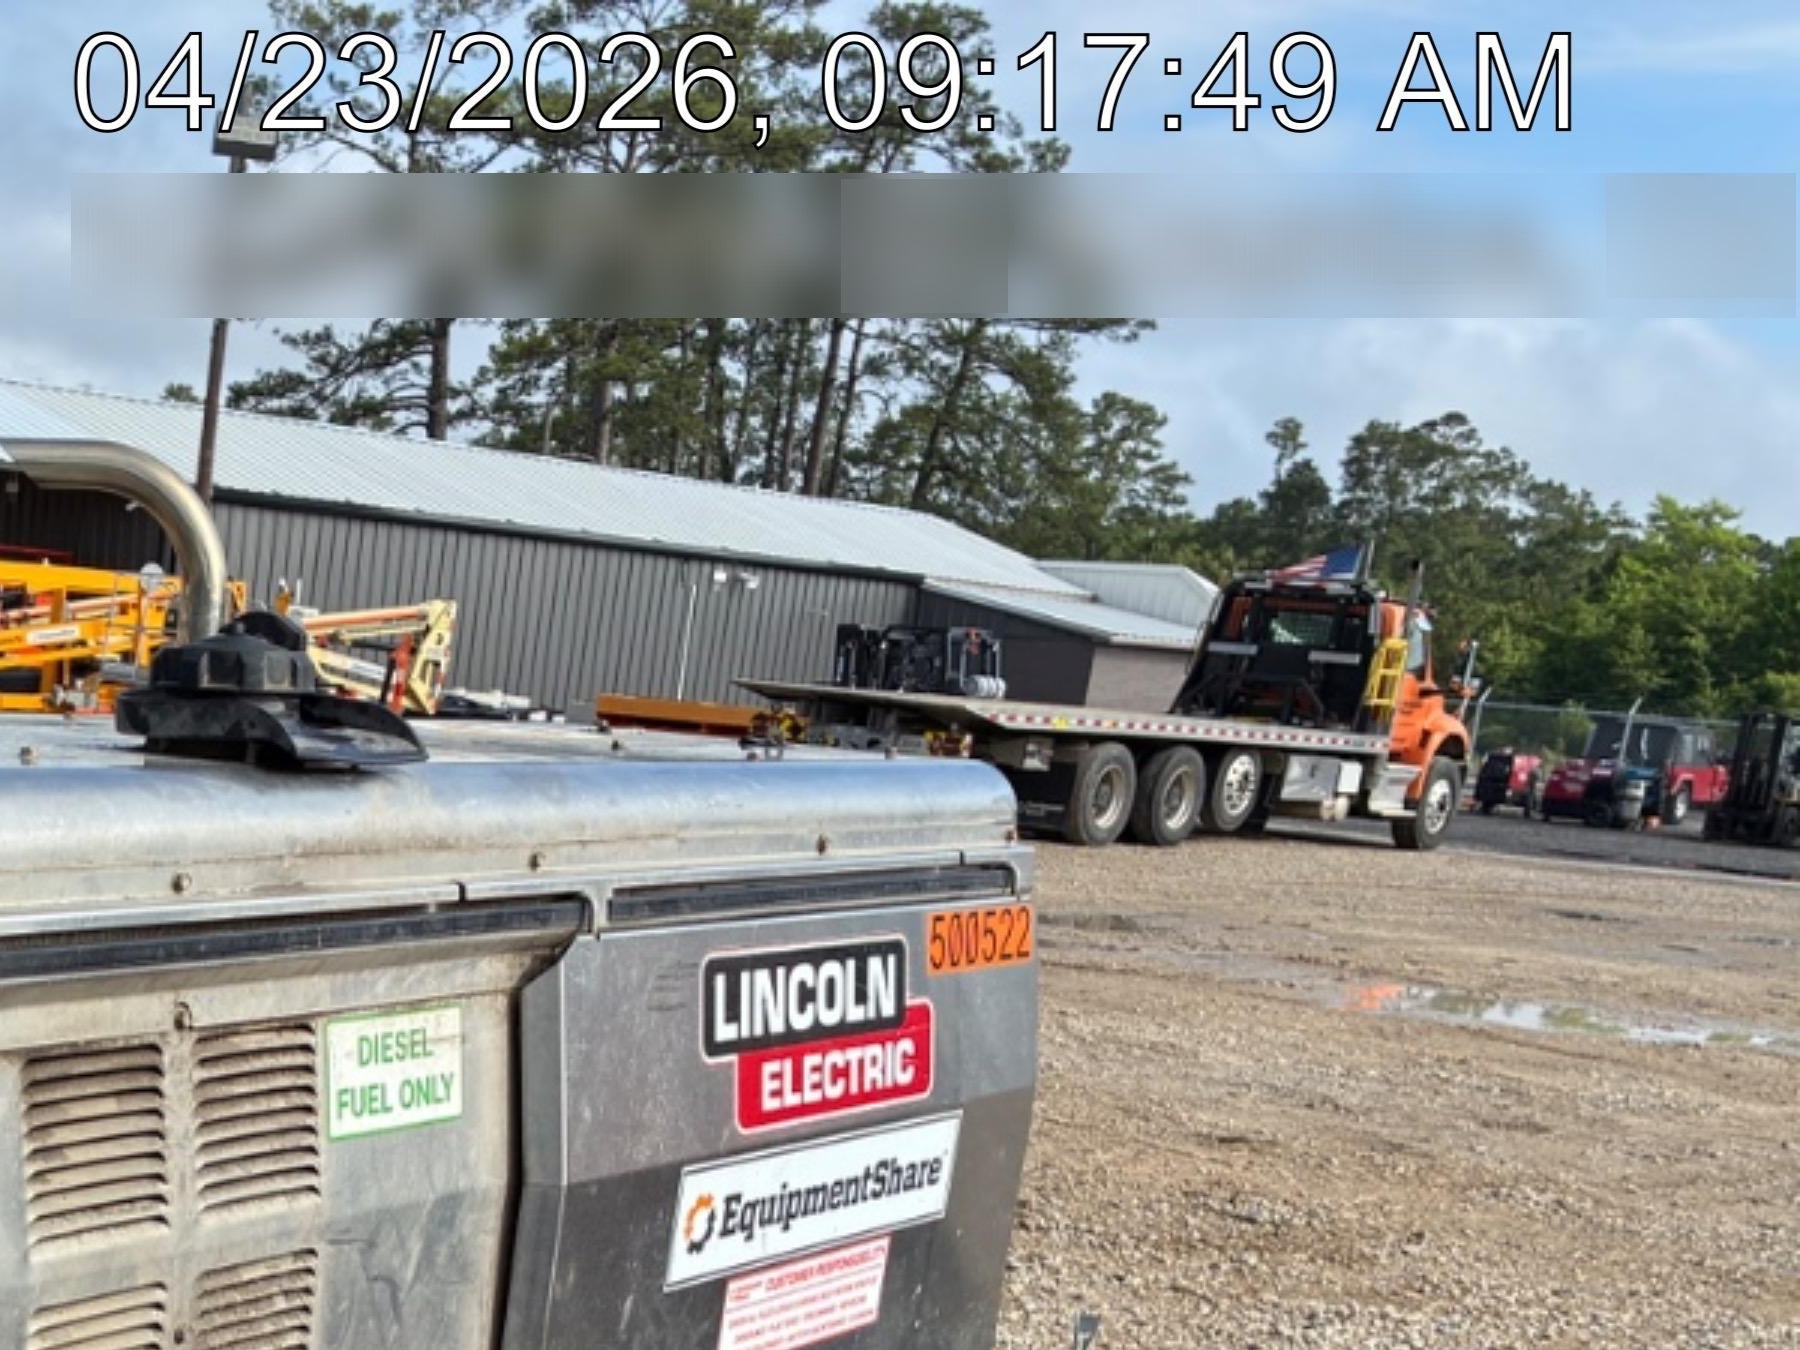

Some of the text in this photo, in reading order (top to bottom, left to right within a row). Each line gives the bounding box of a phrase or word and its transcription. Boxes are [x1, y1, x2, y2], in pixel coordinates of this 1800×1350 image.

[929, 907, 1032, 970] 500522
[714, 953, 897, 1043] LINCOLN
[357, 1026, 435, 1068] DIESEL
[761, 1037, 916, 1112] ELECTRIC
[336, 1071, 455, 1120] FUEL ONLY
[718, 1156, 942, 1242] EquipmentShare
